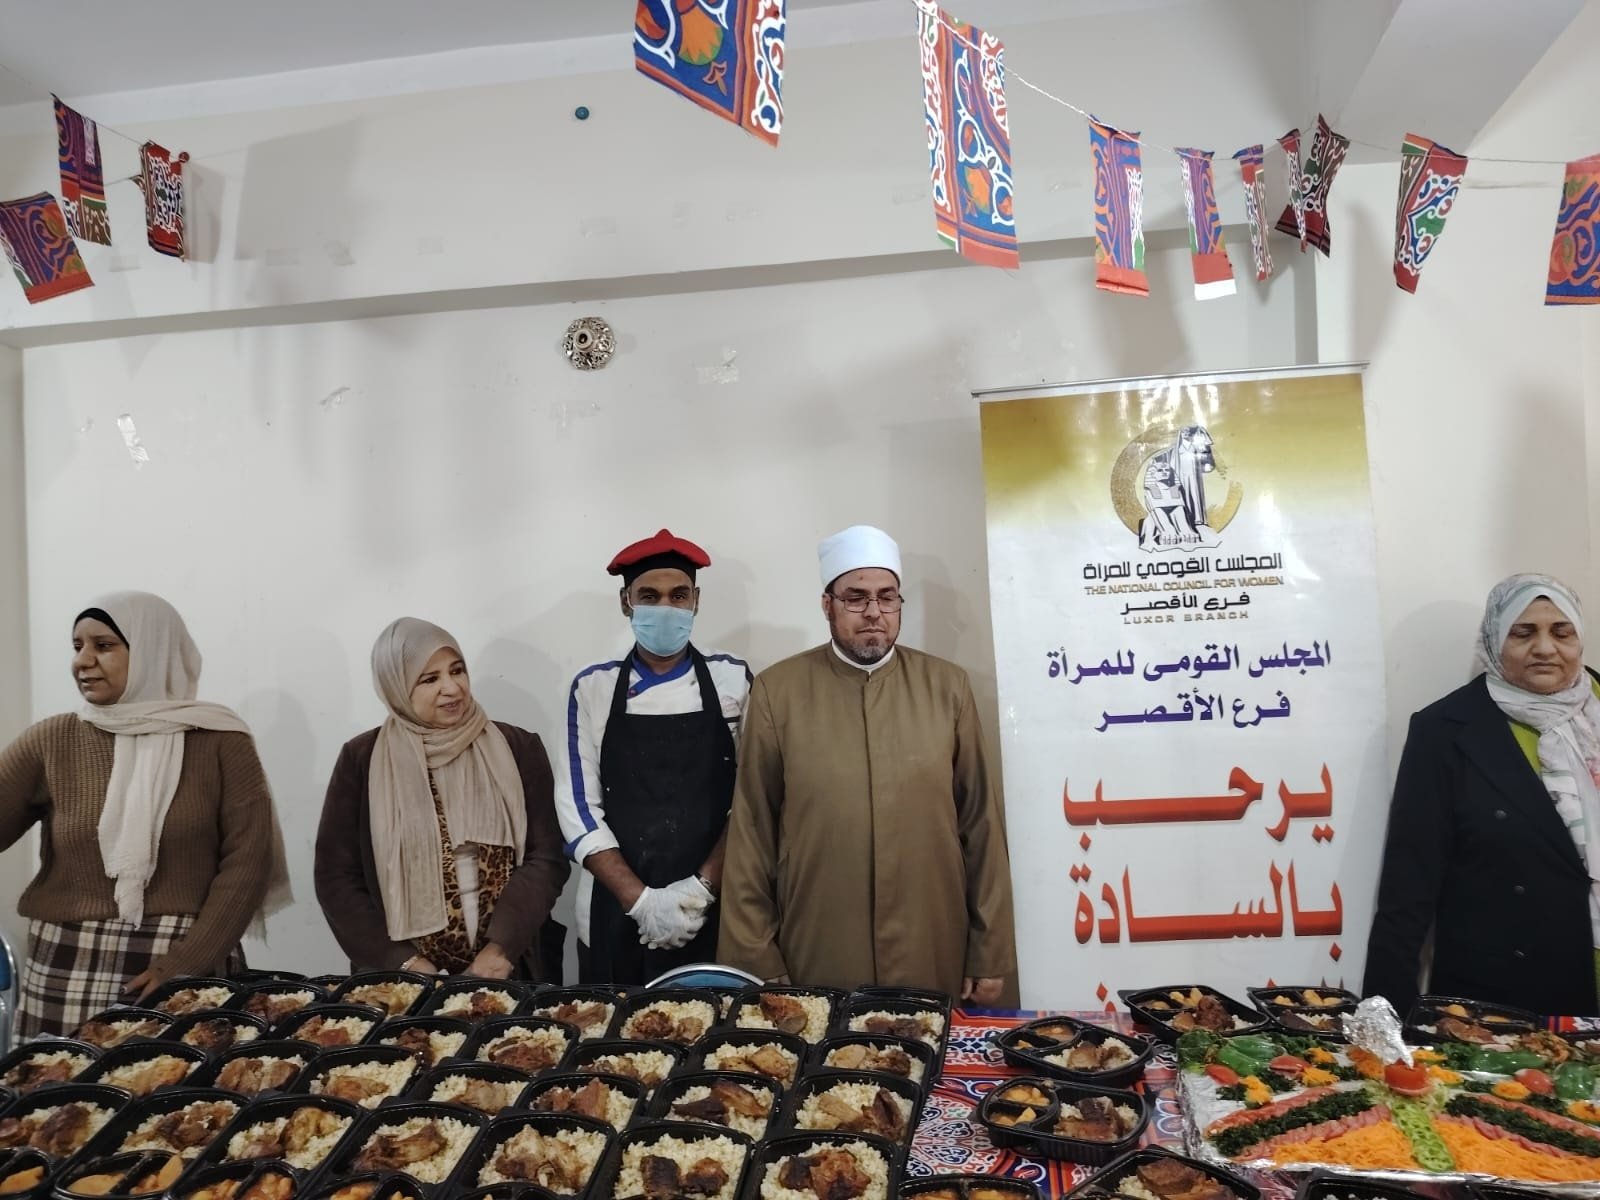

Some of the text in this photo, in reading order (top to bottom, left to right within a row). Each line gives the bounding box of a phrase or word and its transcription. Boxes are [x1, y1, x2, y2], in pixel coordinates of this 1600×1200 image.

[1137, 556, 1209, 579] القومي
[1215, 552, 1283, 573] المجلس
[1084, 576, 1284, 595] THE NATIONAL COUNCIL FOR WOMEN
[1204, 591, 1250, 610] فرع
[1124, 611, 1248, 624] LUXOR BRANCH
[1046, 646, 1135, 685] للمرأة
[1248, 640, 1331, 678] المجلس
[1094, 687, 1291, 732] فرع الأقصر
[1063, 762, 1335, 852] يرحب
[1069, 858, 1343, 962] بالسادة
